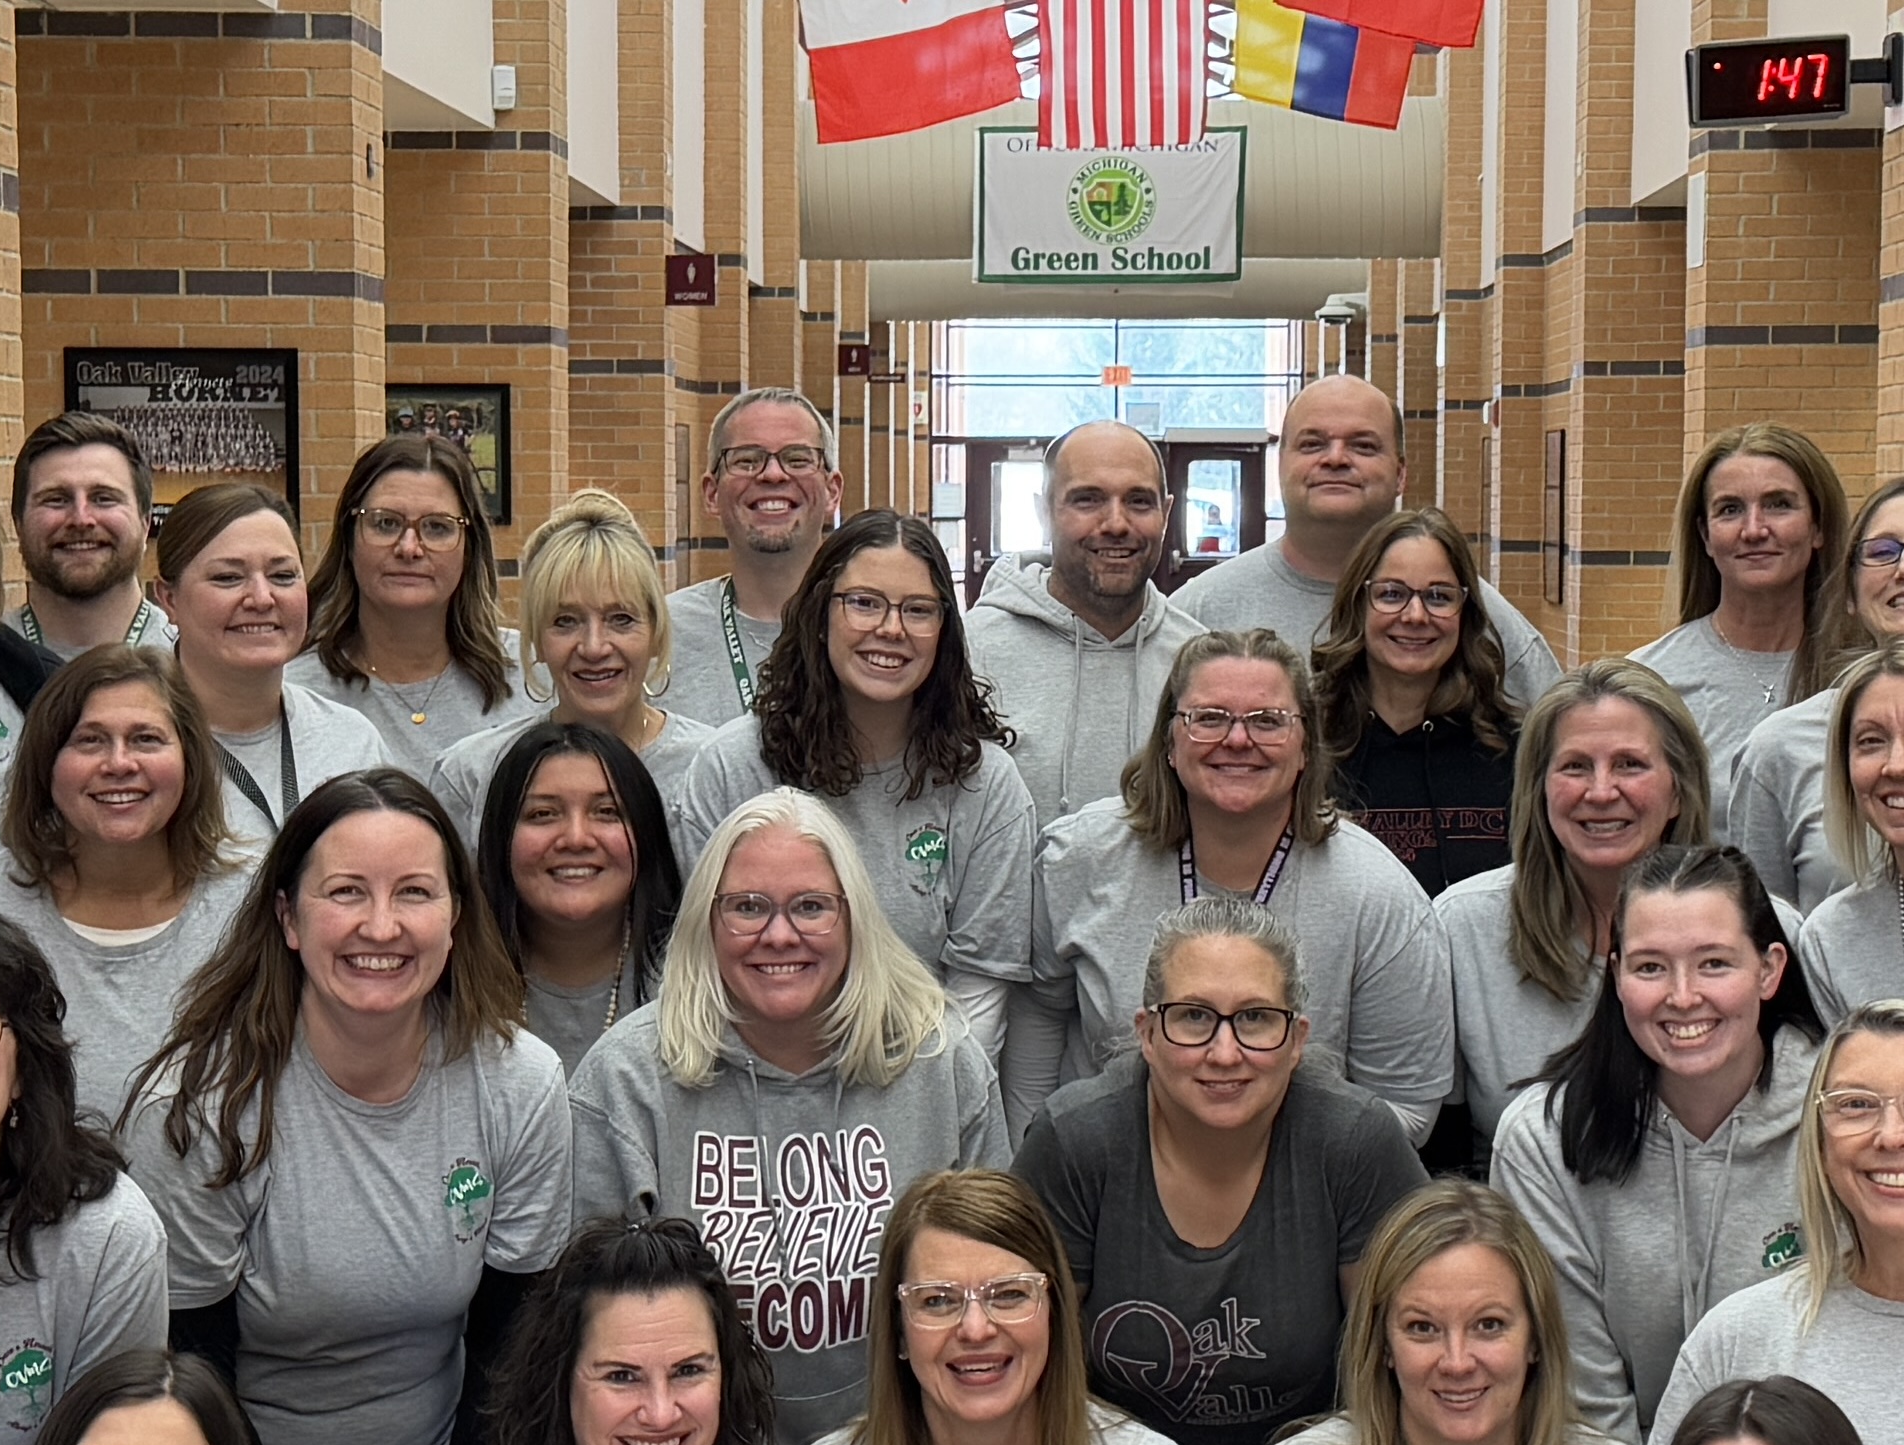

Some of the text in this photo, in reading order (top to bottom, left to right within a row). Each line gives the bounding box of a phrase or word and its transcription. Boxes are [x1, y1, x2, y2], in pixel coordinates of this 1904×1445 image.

[1757, 53, 1829, 101] 1:47
[1075, 157, 1148, 184] MICHIGAN
[1010, 245, 1211, 272] Green School
[674, 291, 708, 301] WOMEN
[77, 362, 285, 385] Oak Valley 2024
[691, 1124, 892, 1211] BELONG
[699, 1198, 895, 1281] BELIEVE
